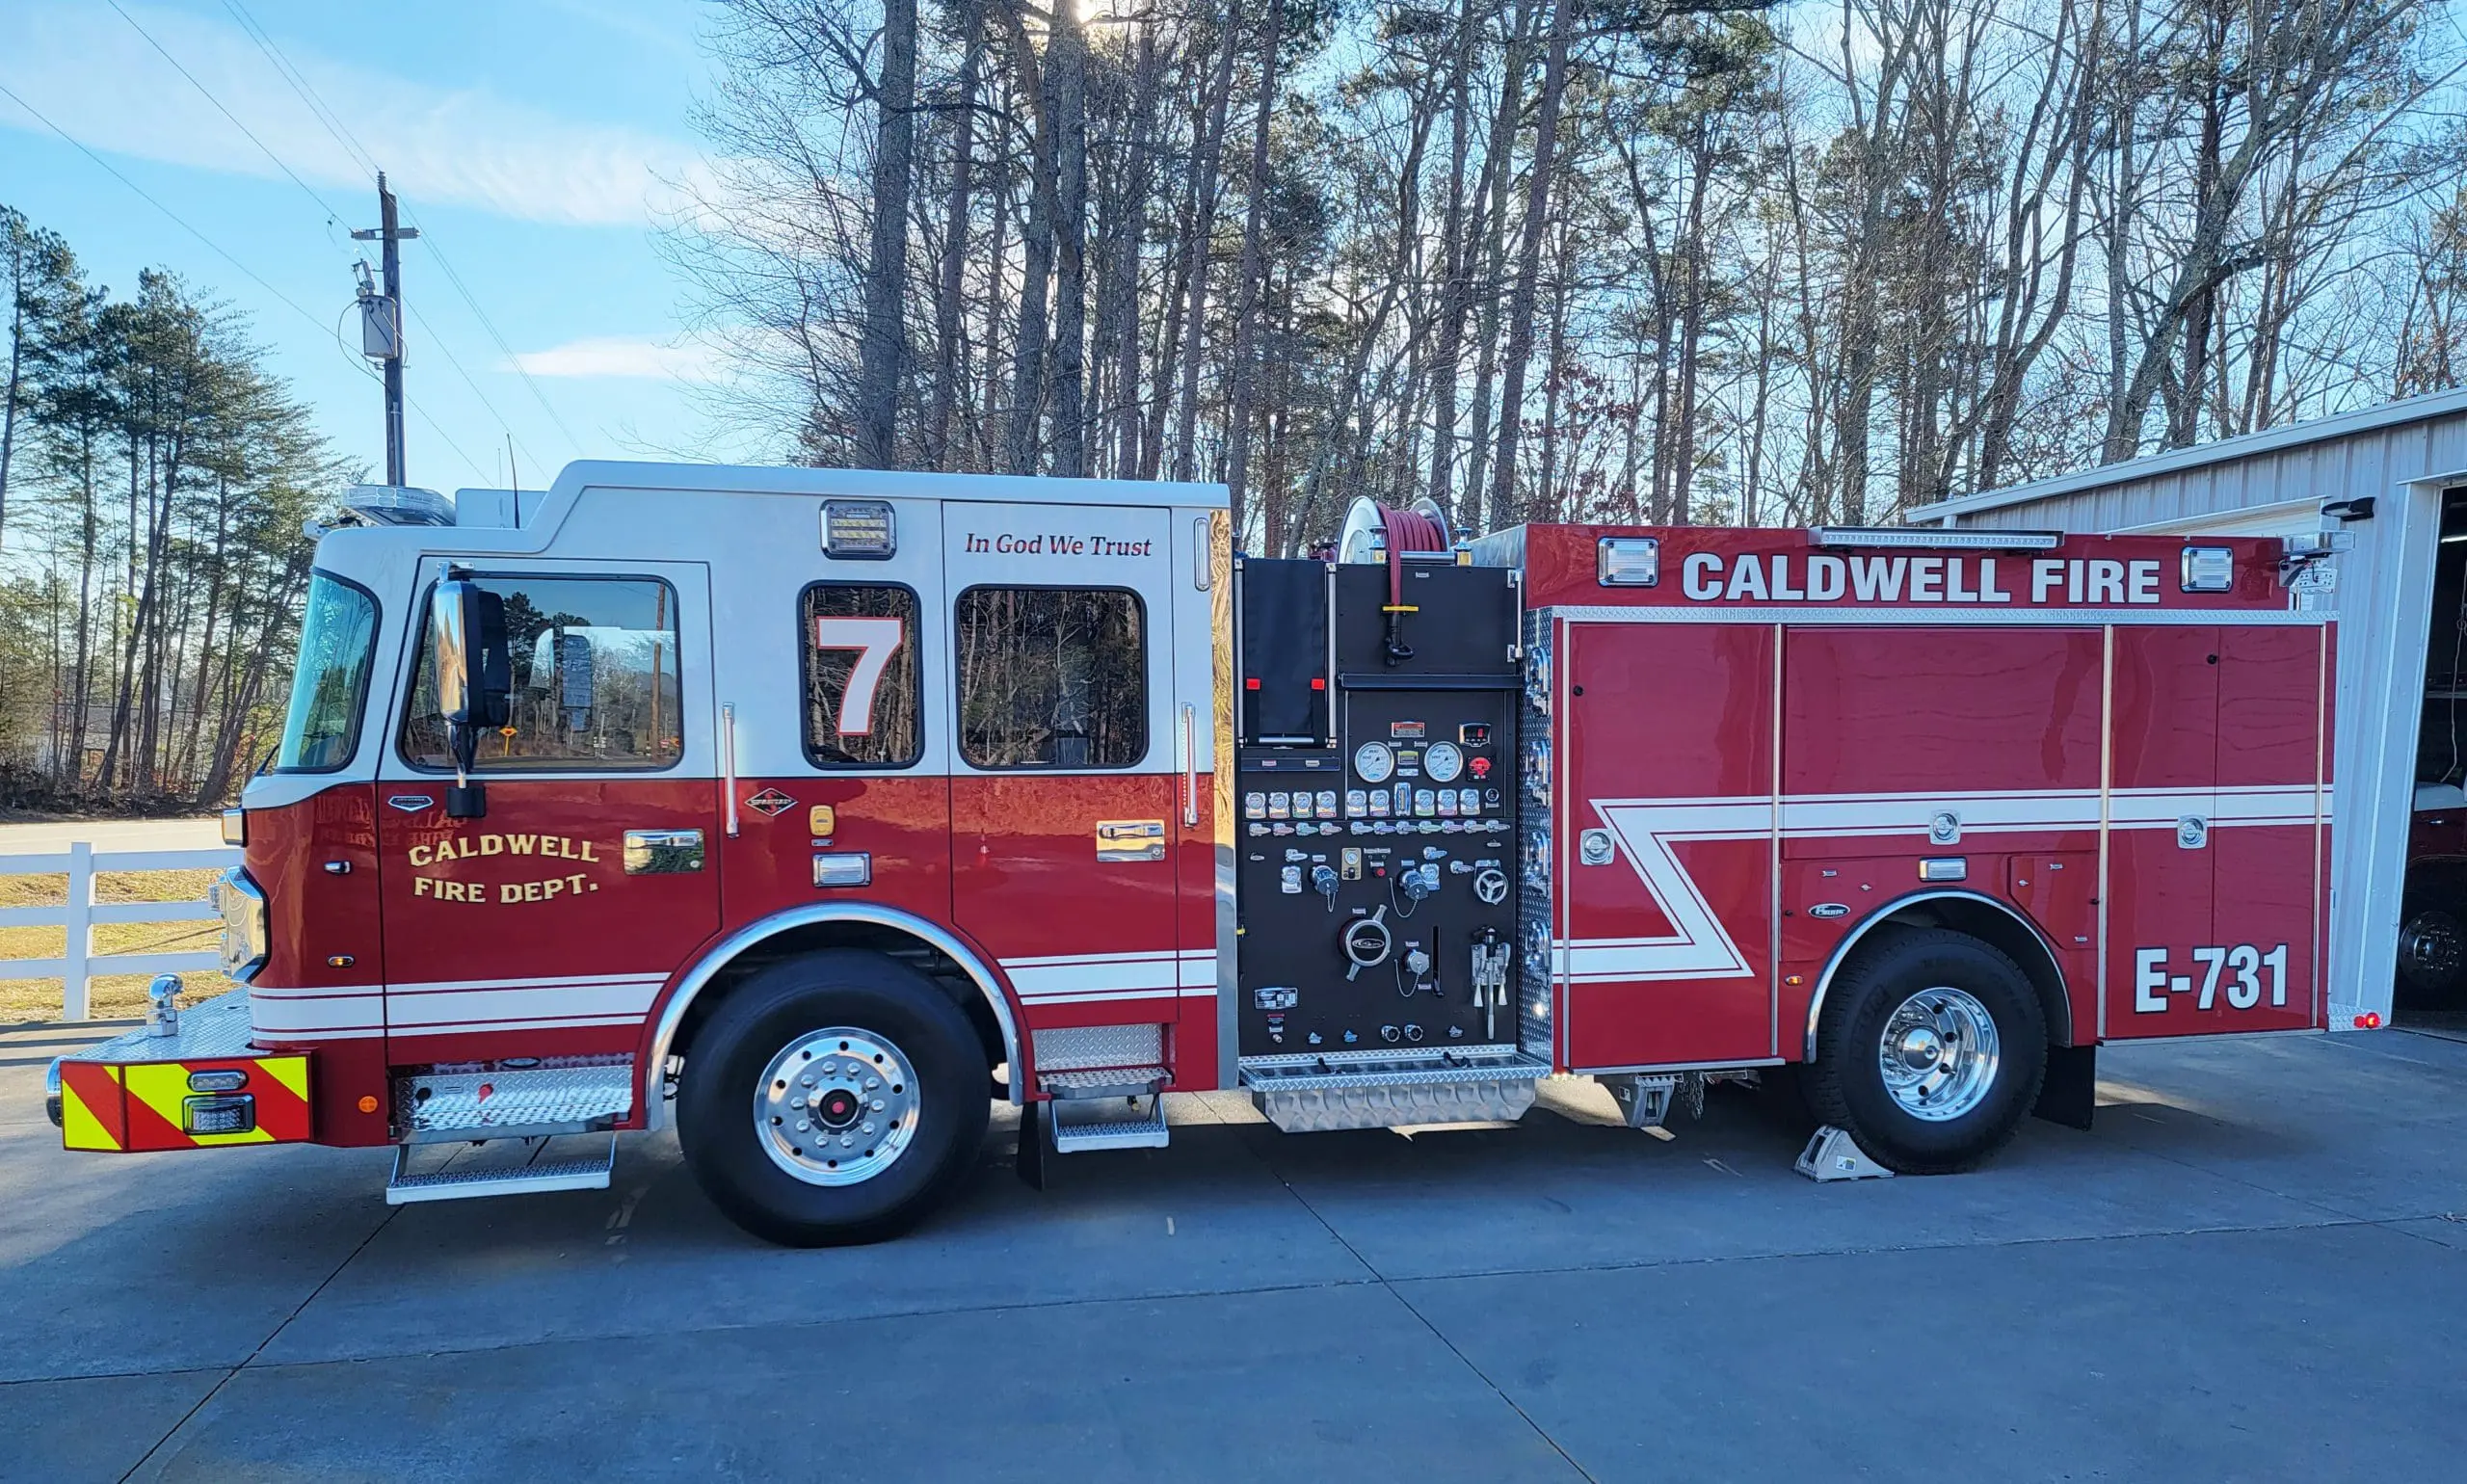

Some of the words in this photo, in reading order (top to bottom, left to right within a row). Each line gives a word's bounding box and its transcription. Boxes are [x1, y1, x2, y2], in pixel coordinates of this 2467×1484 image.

[965, 532, 990, 553] In
[995, 533, 1043, 554] God
[1049, 535, 1084, 555] We
[1090, 536, 1153, 557] Trust
[1682, 552, 2011, 603] CALDWELL
[2030, 558, 2161, 605] FIRE
[816, 616, 904, 737] 7
[408, 834, 600, 866] CALDWELL
[413, 876, 487, 903] FIRE
[499, 873, 598, 904] DEPT.
[2135, 942, 2289, 1015] E-731
